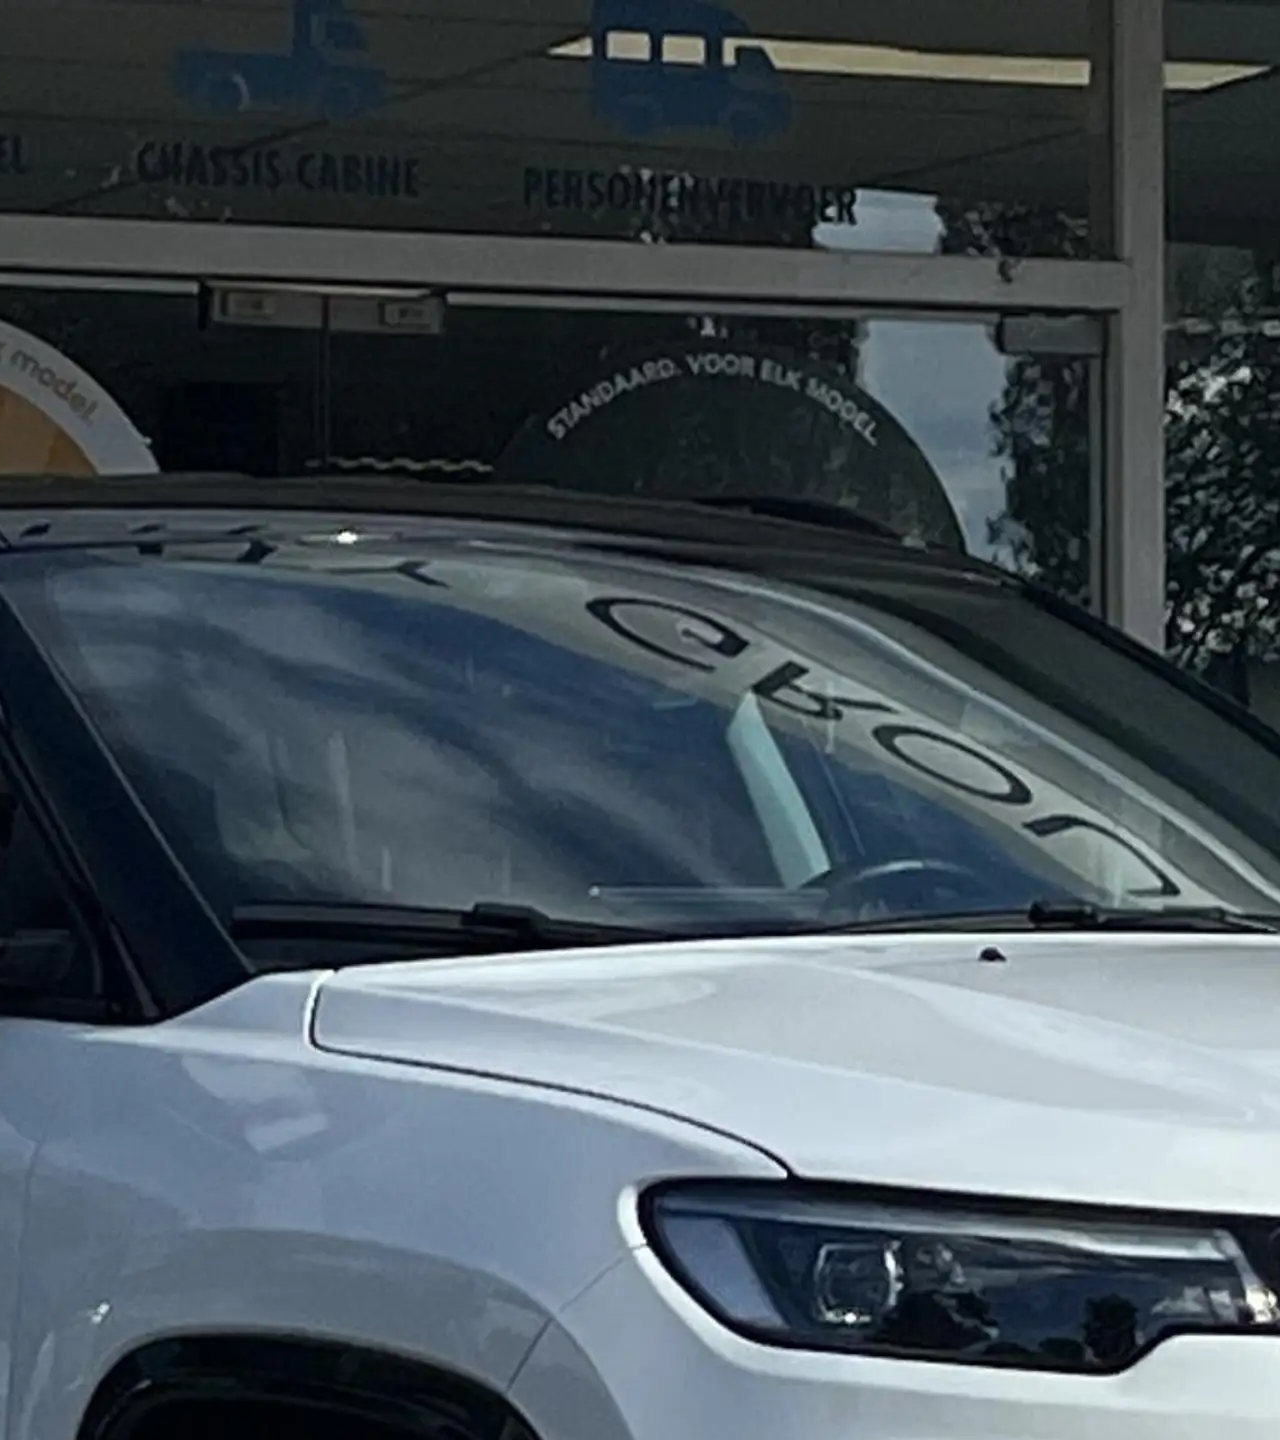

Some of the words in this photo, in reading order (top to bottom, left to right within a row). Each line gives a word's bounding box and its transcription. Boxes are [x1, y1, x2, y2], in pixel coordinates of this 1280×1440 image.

[136, 140, 282, 189] CHASSIS
[296, 150, 421, 199] CABINE
[684, 352, 756, 379] VOOR
[760, 358, 803, 391] ELK
